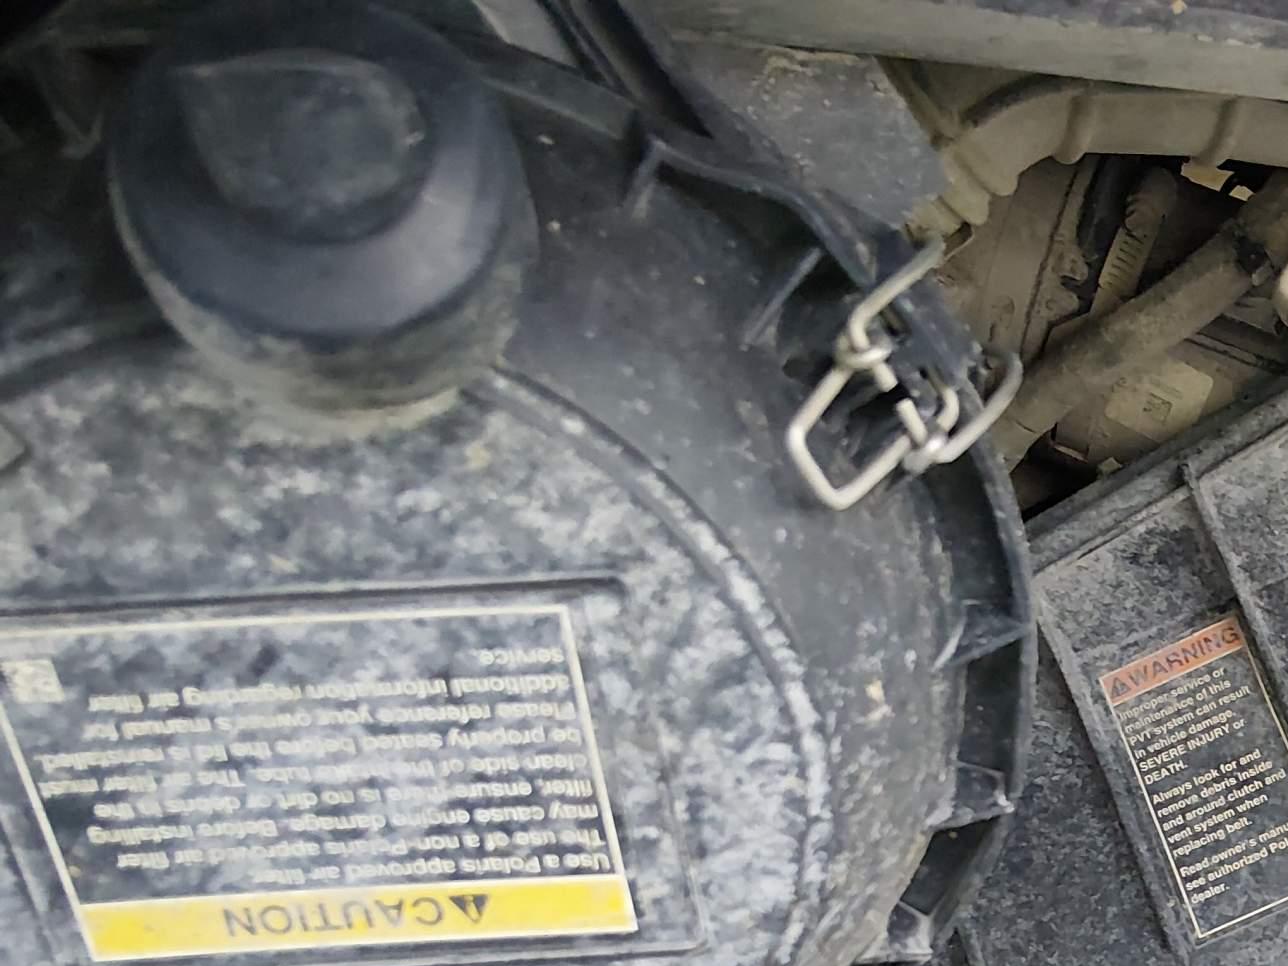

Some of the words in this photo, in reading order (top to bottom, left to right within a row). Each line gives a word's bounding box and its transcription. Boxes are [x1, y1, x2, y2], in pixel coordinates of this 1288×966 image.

[470, 645, 563, 666] service.
[1128, 625, 1238, 686] WARNING
[180, 681, 303, 707] regarding
[305, 678, 448, 703] information
[449, 673, 570, 695] additional
[1120, 693, 1169, 721] Improper
[1171, 674, 1210, 696] service
[1212, 667, 1224, 677] or
[84, 694, 144, 715] filter
[145, 692, 182, 709] air
[1125, 695, 1193, 732] maintenance
[1195, 689, 1206, 700] of
[1208, 678, 1230, 694] this
[313, 704, 372, 726] your
[375, 703, 491, 724] reference
[494, 701, 576, 721] Please
[1129, 729, 1151, 745] PVT
[1153, 711, 1194, 736] system
[1196, 702, 1215, 715] can
[1218, 685, 1249, 705] result
[77, 723, 119, 741] for
[119, 718, 213, 738] manual
[446, 724, 546, 748] properly
[550, 727, 581, 744] be
[194, 744, 228, 761] lid
[227, 742, 272, 760] the
[273, 737, 356, 757] before
[359, 733, 444, 753] seated
[1135, 748, 1145, 758] in
[1147, 729, 1186, 752] vehicle
[1139, 744, 1185, 771] SEVERE
[1187, 724, 1230, 750] INJURY
[1232, 719, 1244, 729] or
[166, 746, 192, 762] is
[468, 756, 520, 772] side
[522, 753, 587, 770] clean
[437, 759, 465, 775] of
[1144, 759, 1187, 784] DEATH.
[1152, 780, 1192, 805] Always
[1193, 767, 1218, 785] look
[1220, 759, 1237, 773] for
[1238, 749, 1260, 765] and
[37, 778, 100, 796] must
[99, 775, 158, 792] filter
[159, 773, 193, 788] air
[196, 770, 245, 787] The
[1157, 793, 1198, 817] remove
[1200, 775, 1236, 798] debris
[1237, 759, 1273, 781] inside
[320, 791, 354, 803] no
[358, 789, 382, 803] is
[453, 782, 532, 797] ensure
[1162, 815, 1183, 830] and
[1185, 796, 1225, 820] around
[1226, 779, 1262, 801] clutch
[1264, 769, 1285, 784] and
[135, 801, 162, 815] in
[162, 796, 242, 816] debris
[243, 795, 272, 807] or
[277, 792, 319, 808] dirt
[547, 799, 598, 818] may
[91, 802, 134, 819] the
[389, 806, 470, 827] engine
[472, 806, 545, 821] cause
[1167, 827, 1191, 843] vent
[1193, 807, 1235, 833] system
[1236, 792, 1267, 813] when
[85, 821, 195, 845] installing
[194, 821, 277, 839] Before
[514, 830, 555, 843] use
[558, 828, 605, 847] The
[1172, 828, 1225, 859] replacing
[1226, 815, 1252, 833] belt.
[323, 836, 460, 857] non-Polaris
[463, 835, 480, 846] a
[482, 833, 510, 850] of
[113, 852, 170, 870] filter
[172, 849, 205, 865] air
[203, 840, 322, 863] approved
[542, 855, 560, 867] a
[563, 852, 609, 871] Use
[1180, 857, 1208, 877] Read
[1211, 836, 1256, 863] owner's
[308, 866, 341, 881] air
[341, 857, 457, 883] approved
[461, 856, 540, 875] Polaris
[1185, 877, 1205, 890] see
[1207, 847, 1267, 881] authorized
[1190, 880, 1229, 904] dealer.
[220, 896, 447, 936] CAUTION
